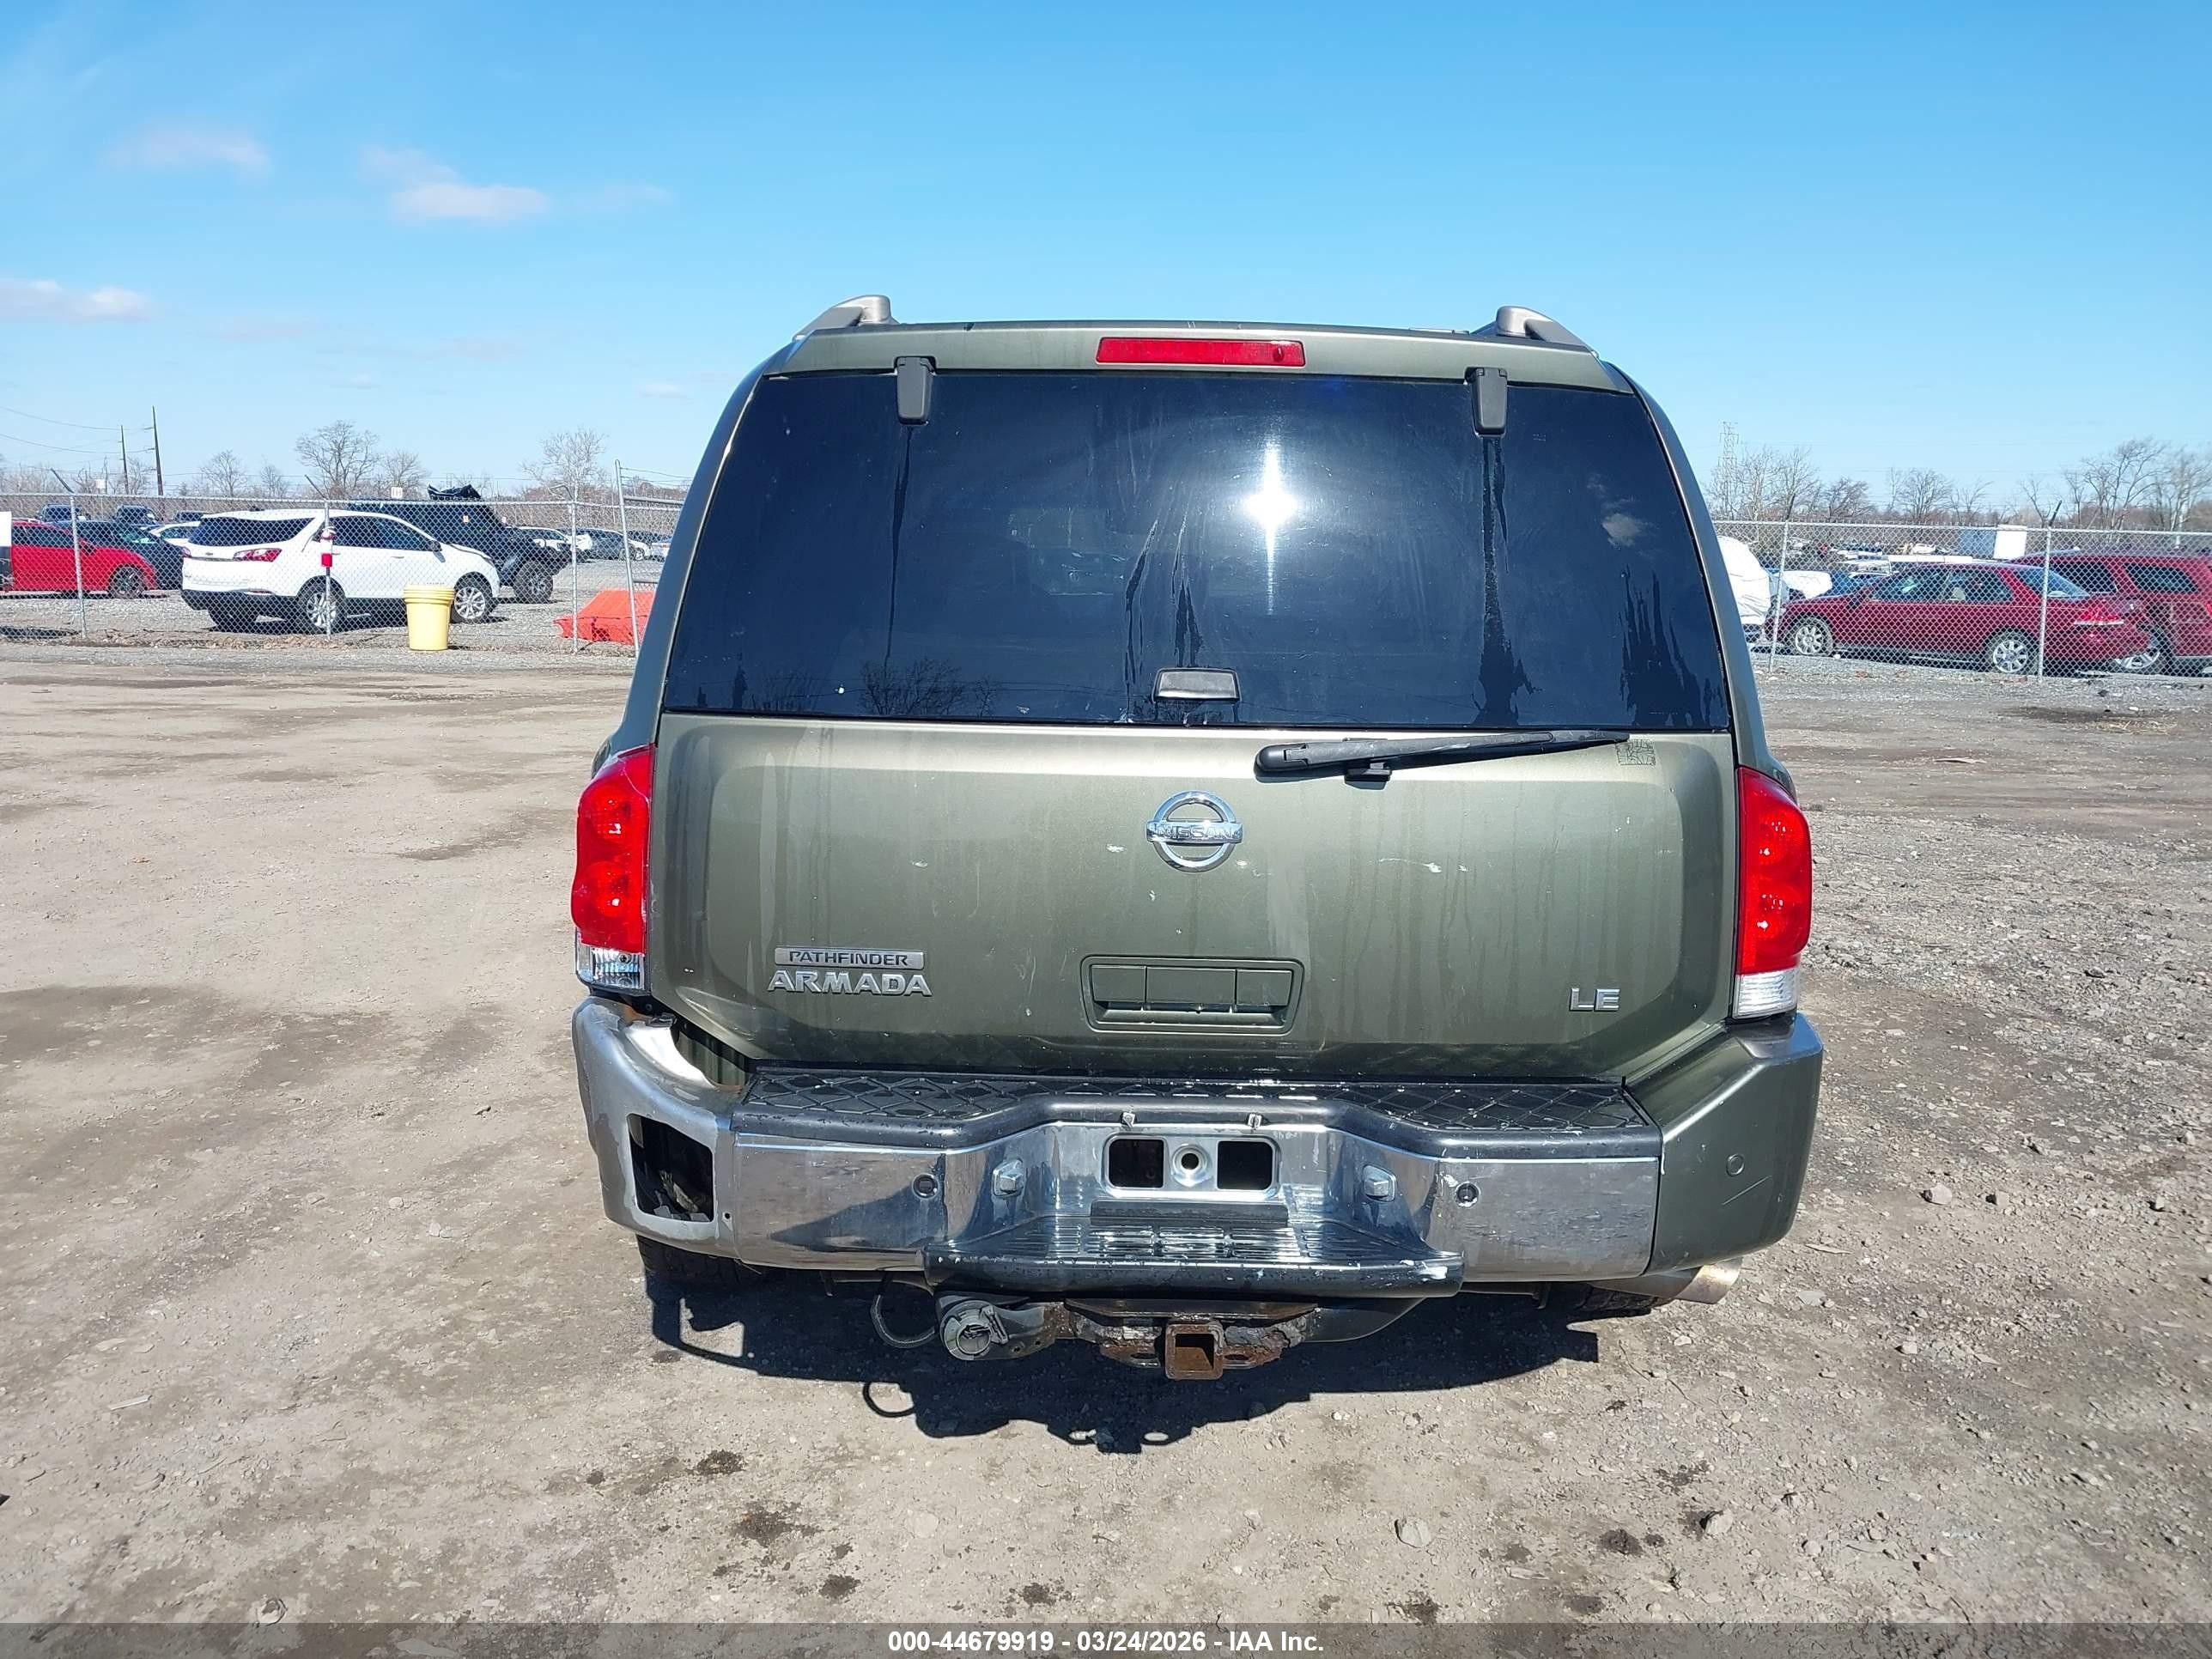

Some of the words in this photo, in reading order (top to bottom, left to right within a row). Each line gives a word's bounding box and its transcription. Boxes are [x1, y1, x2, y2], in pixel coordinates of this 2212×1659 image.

[1157, 824, 1234, 840] NISSAN
[789, 951, 908, 966] PATHFINDER
[768, 969, 933, 996] ARMADA
[1570, 988, 1620, 1012] LE
